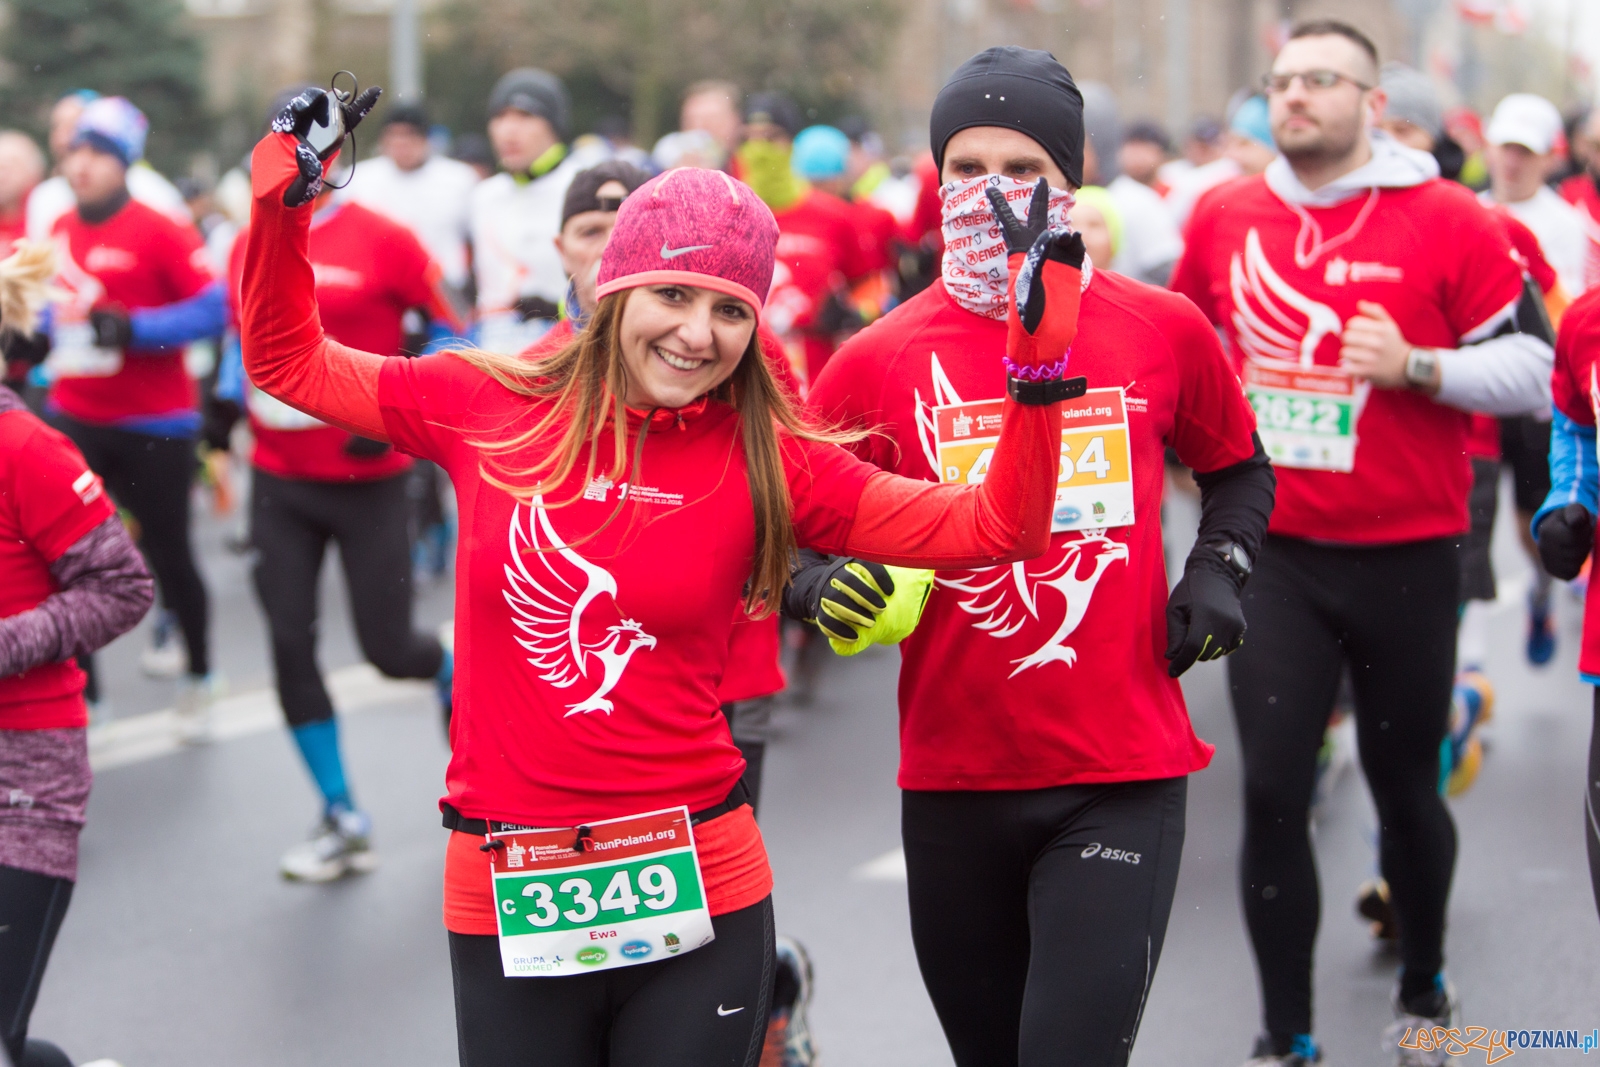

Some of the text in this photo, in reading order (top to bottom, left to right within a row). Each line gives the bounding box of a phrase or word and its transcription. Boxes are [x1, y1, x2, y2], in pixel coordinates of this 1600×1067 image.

[952, 179, 988, 208] ENERVIT
[1002, 187, 1033, 202] ERVI
[996, 198, 1011, 213] DO
[1003, 212, 1021, 232] JUST
[1253, 392, 1341, 433] 2622
[976, 415, 986, 430] 1
[946, 466, 960, 481] D
[617, 482, 629, 500] 1
[528, 845, 539, 862] 1
[594, 829, 676, 851] RunPoland.org
[1100, 847, 1142, 865] asics
[521, 864, 678, 928] 3349
[589, 929, 618, 941] Ewa
[513, 956, 546, 965] GRUPA
[514, 963, 553, 972] LUXMED
